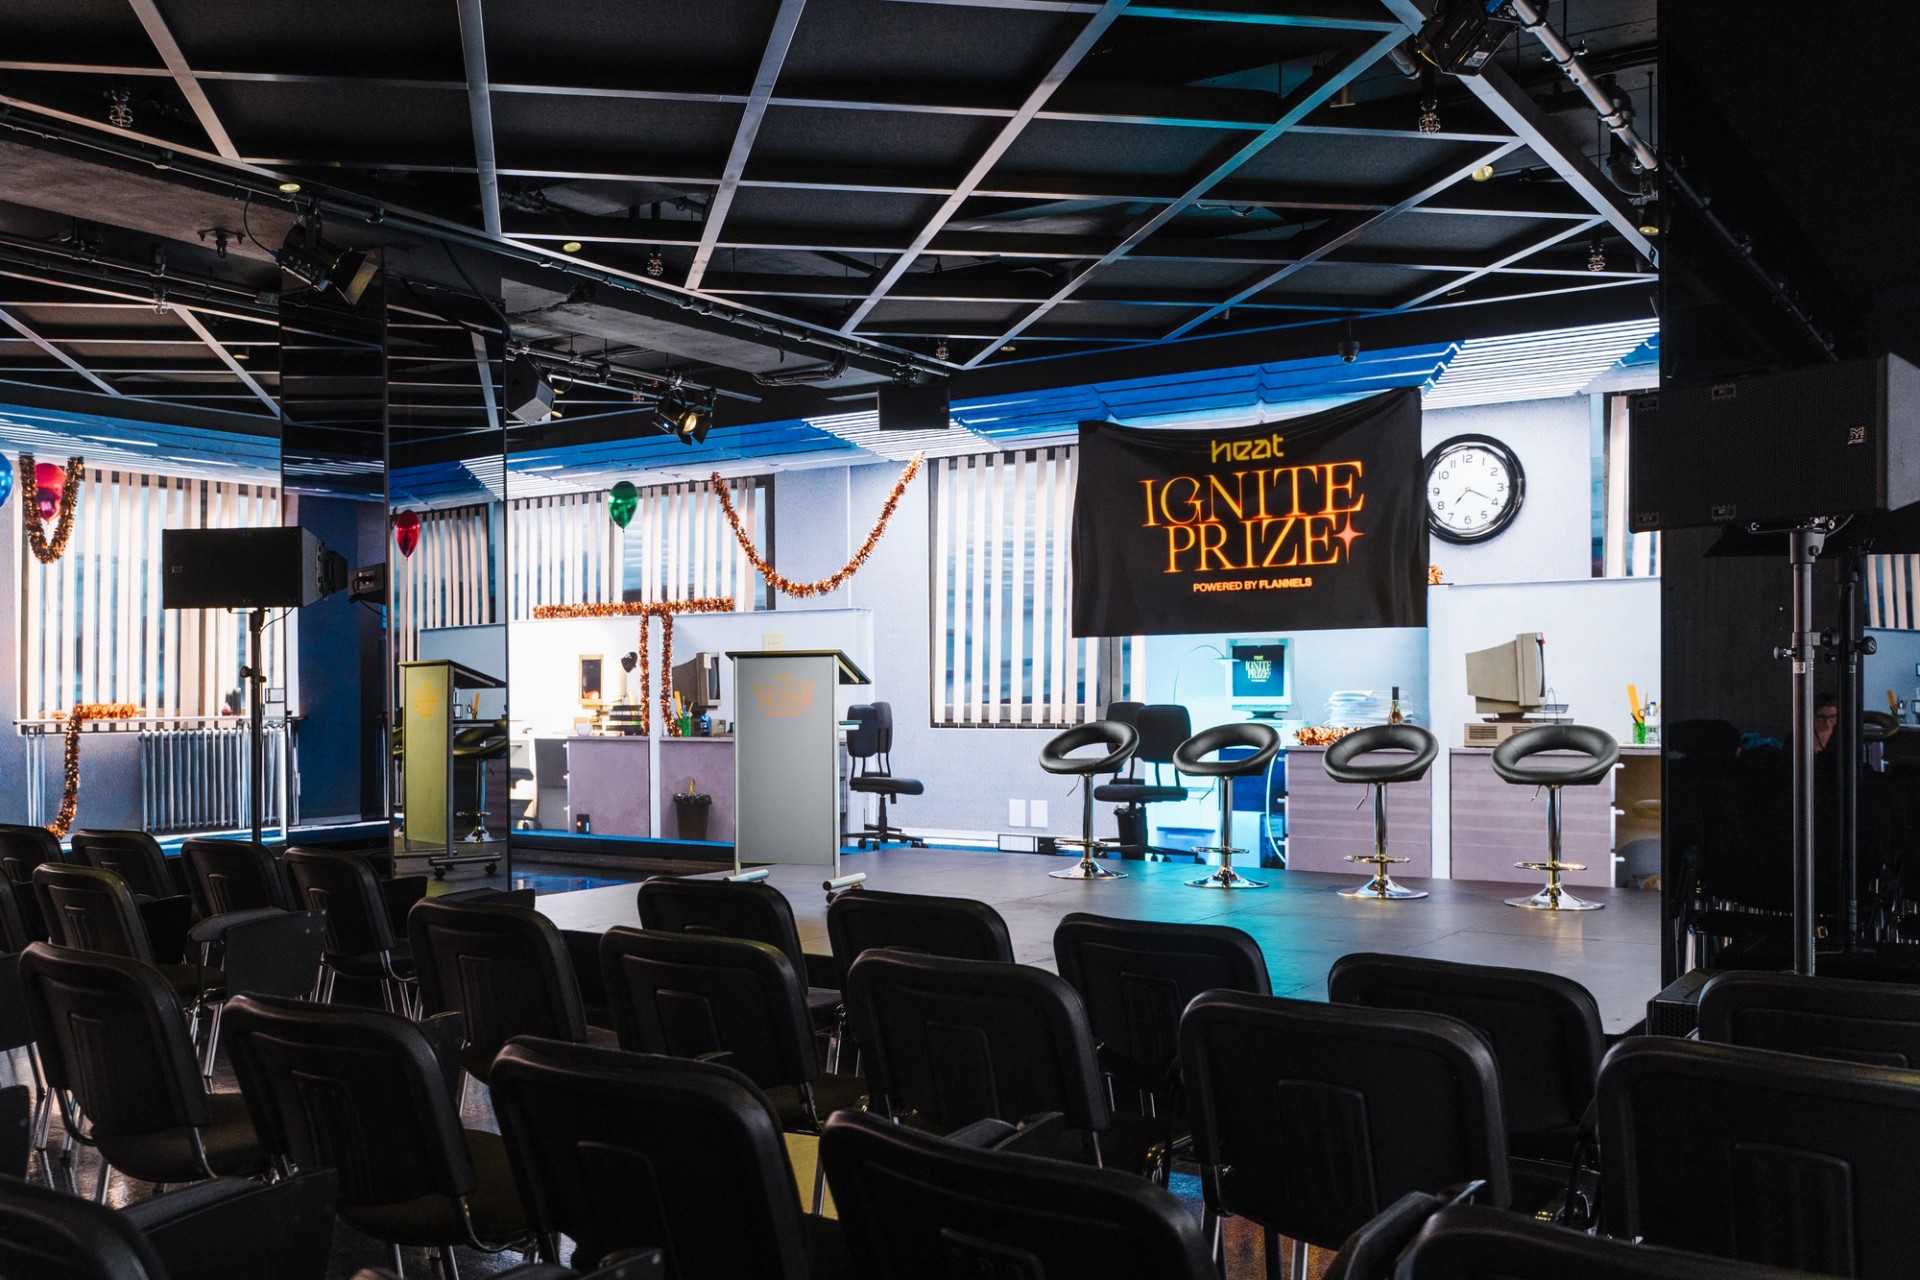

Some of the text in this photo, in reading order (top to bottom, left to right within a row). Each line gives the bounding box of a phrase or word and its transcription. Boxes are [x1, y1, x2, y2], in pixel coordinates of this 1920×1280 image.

[1211, 433, 1285, 463] heat
[1450, 459, 1456, 469] 11
[1462, 454, 1473, 464] 12
[1438, 470, 1450, 480] 10
[1490, 467, 1499, 477] 2
[1432, 487, 1440, 496] 9
[1497, 482, 1504, 492] 3
[1139, 460, 1365, 527] IGNITE
[1437, 500, 1445, 510] 8
[1491, 497, 1499, 506] 4
[1447, 512, 1455, 522] 7
[1464, 515, 1472, 524] 6
[1480, 510, 1488, 520] 5
[1163, 514, 1339, 574] PRIZE
[1193, 577, 1313, 592] POWERED BY FLANNELS
